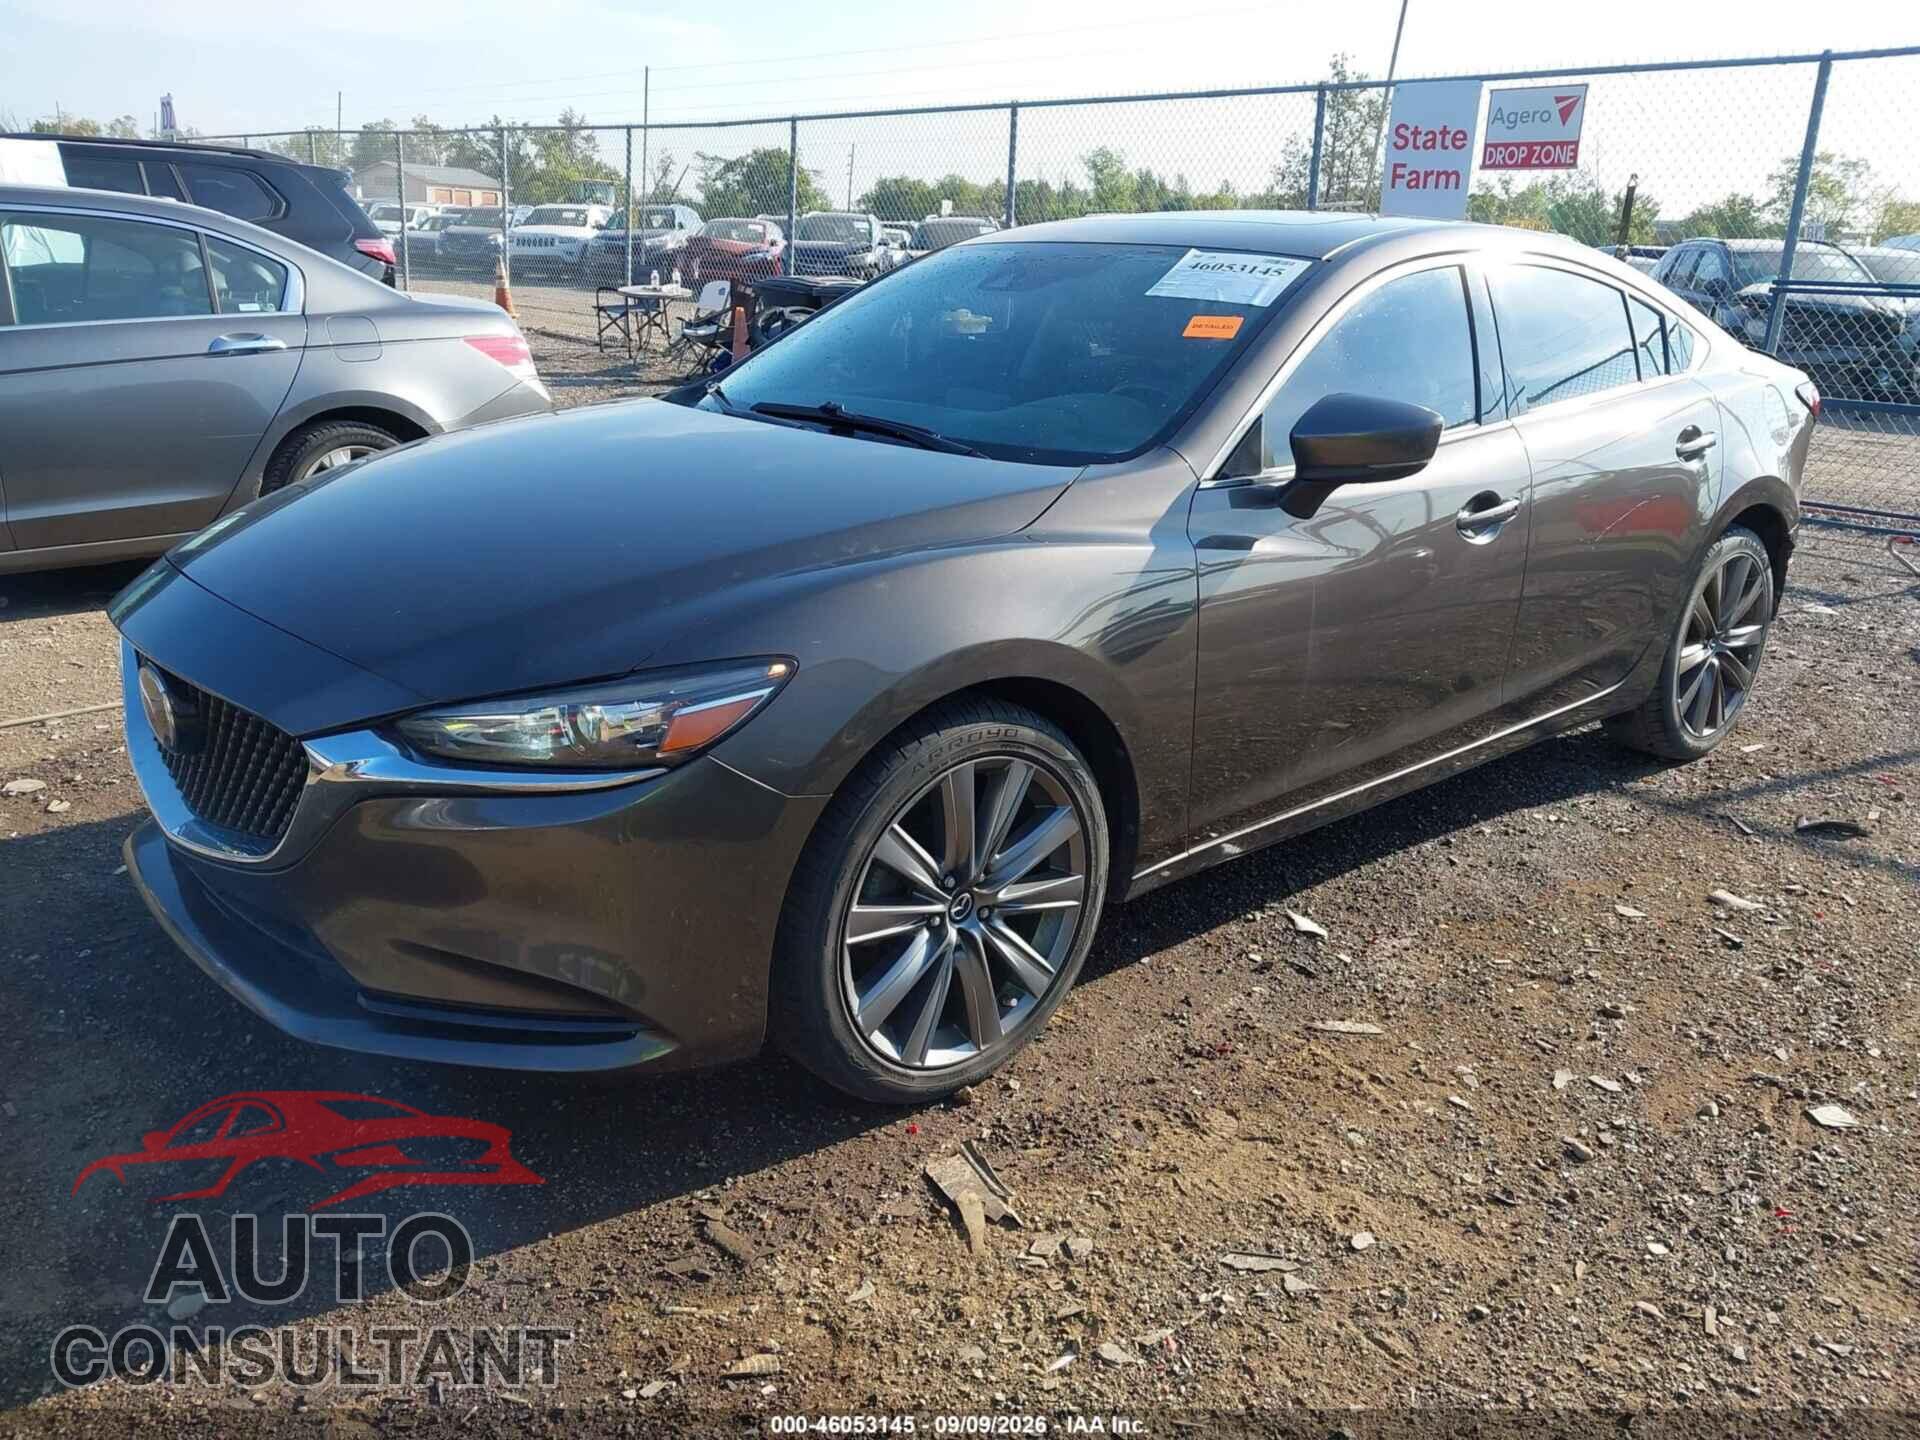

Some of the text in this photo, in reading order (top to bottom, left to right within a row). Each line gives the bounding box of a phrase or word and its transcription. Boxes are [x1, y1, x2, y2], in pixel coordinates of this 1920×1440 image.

[1491, 107, 1551, 130] Agero
[1393, 123, 1468, 150] State
[1485, 144, 1576, 165] DROP ZONE
[1390, 163, 1461, 189] Farm
[1190, 261, 1284, 277] 46053145
